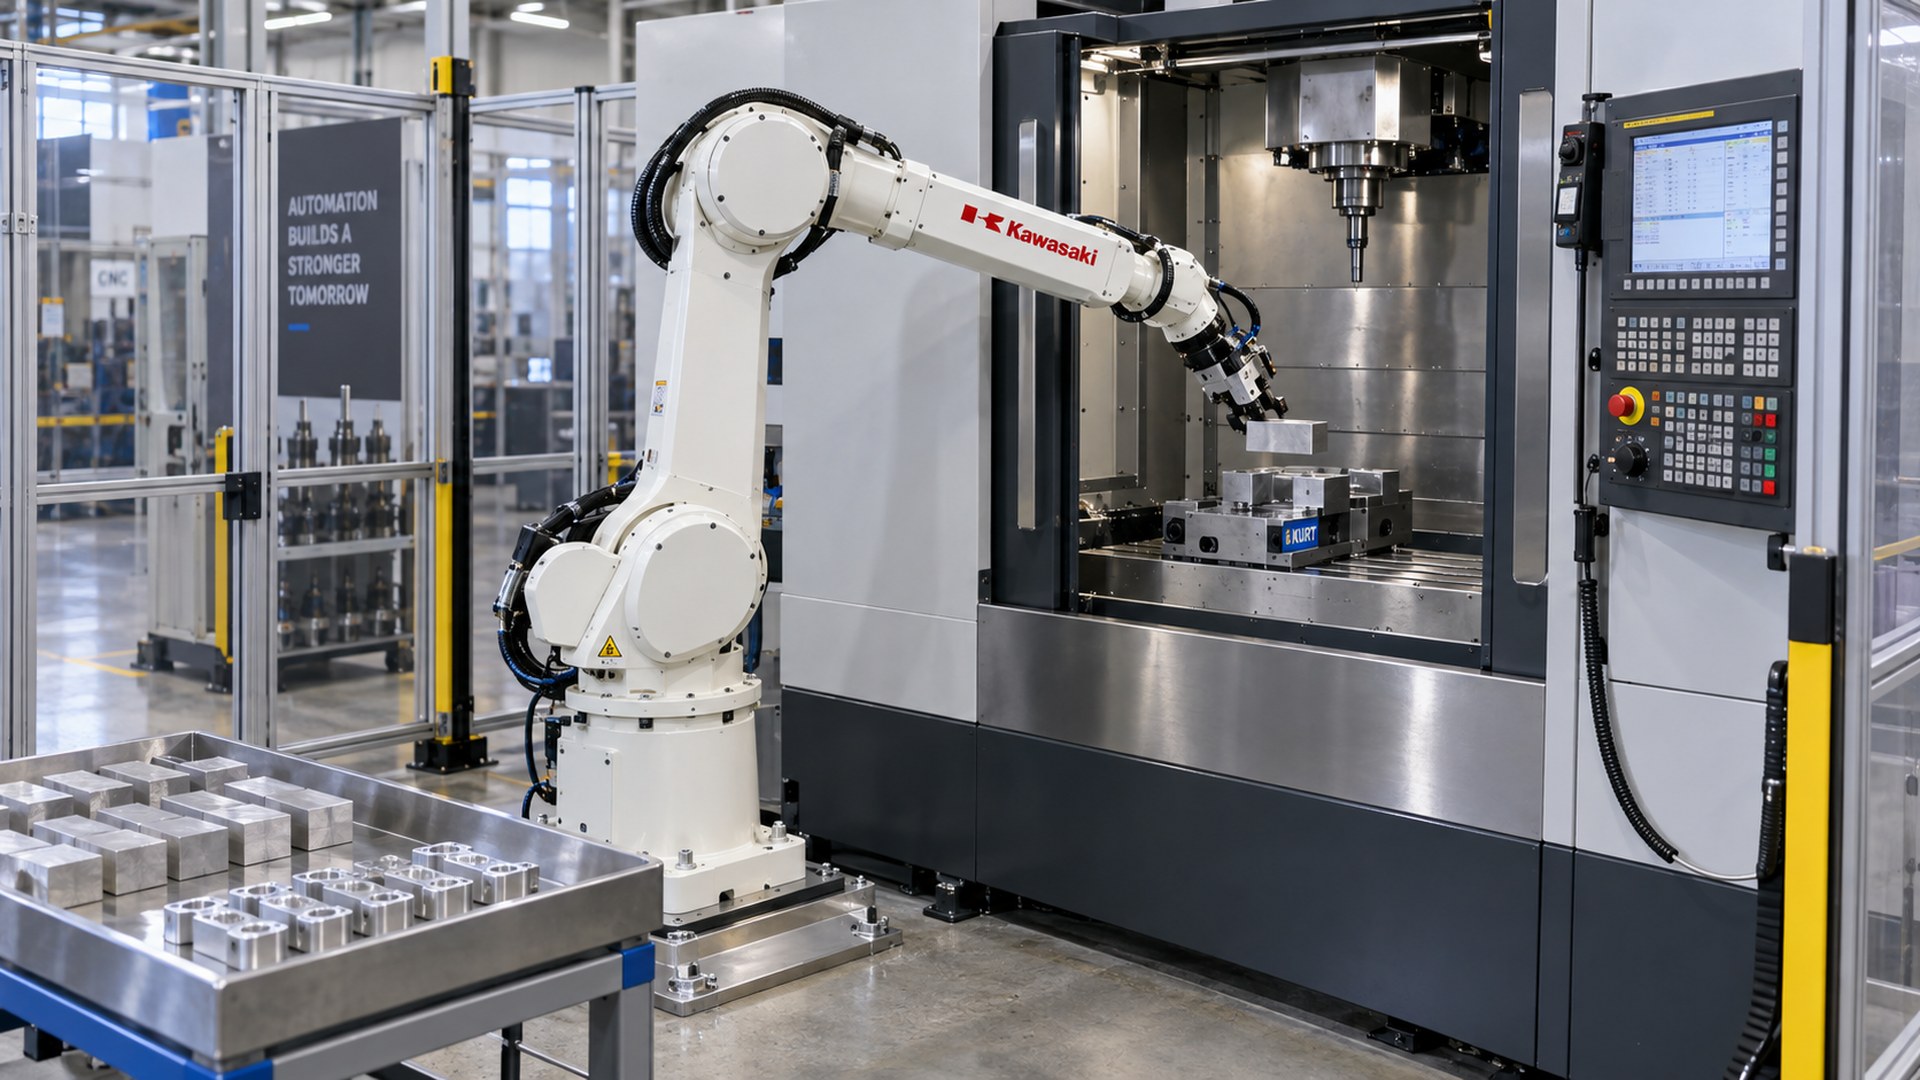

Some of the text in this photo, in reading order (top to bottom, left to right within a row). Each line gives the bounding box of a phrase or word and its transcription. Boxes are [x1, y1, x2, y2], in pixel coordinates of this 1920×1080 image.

[288, 190, 378, 216] AUTOMATION
[288, 222, 352, 246] BUILDS A
[1006, 220, 1098, 266] Kawasaki
[288, 253, 360, 276] STRONGER
[97, 269, 128, 288] CNC
[288, 283, 369, 306] TOMORROW
[1292, 526, 1317, 544] KURT
